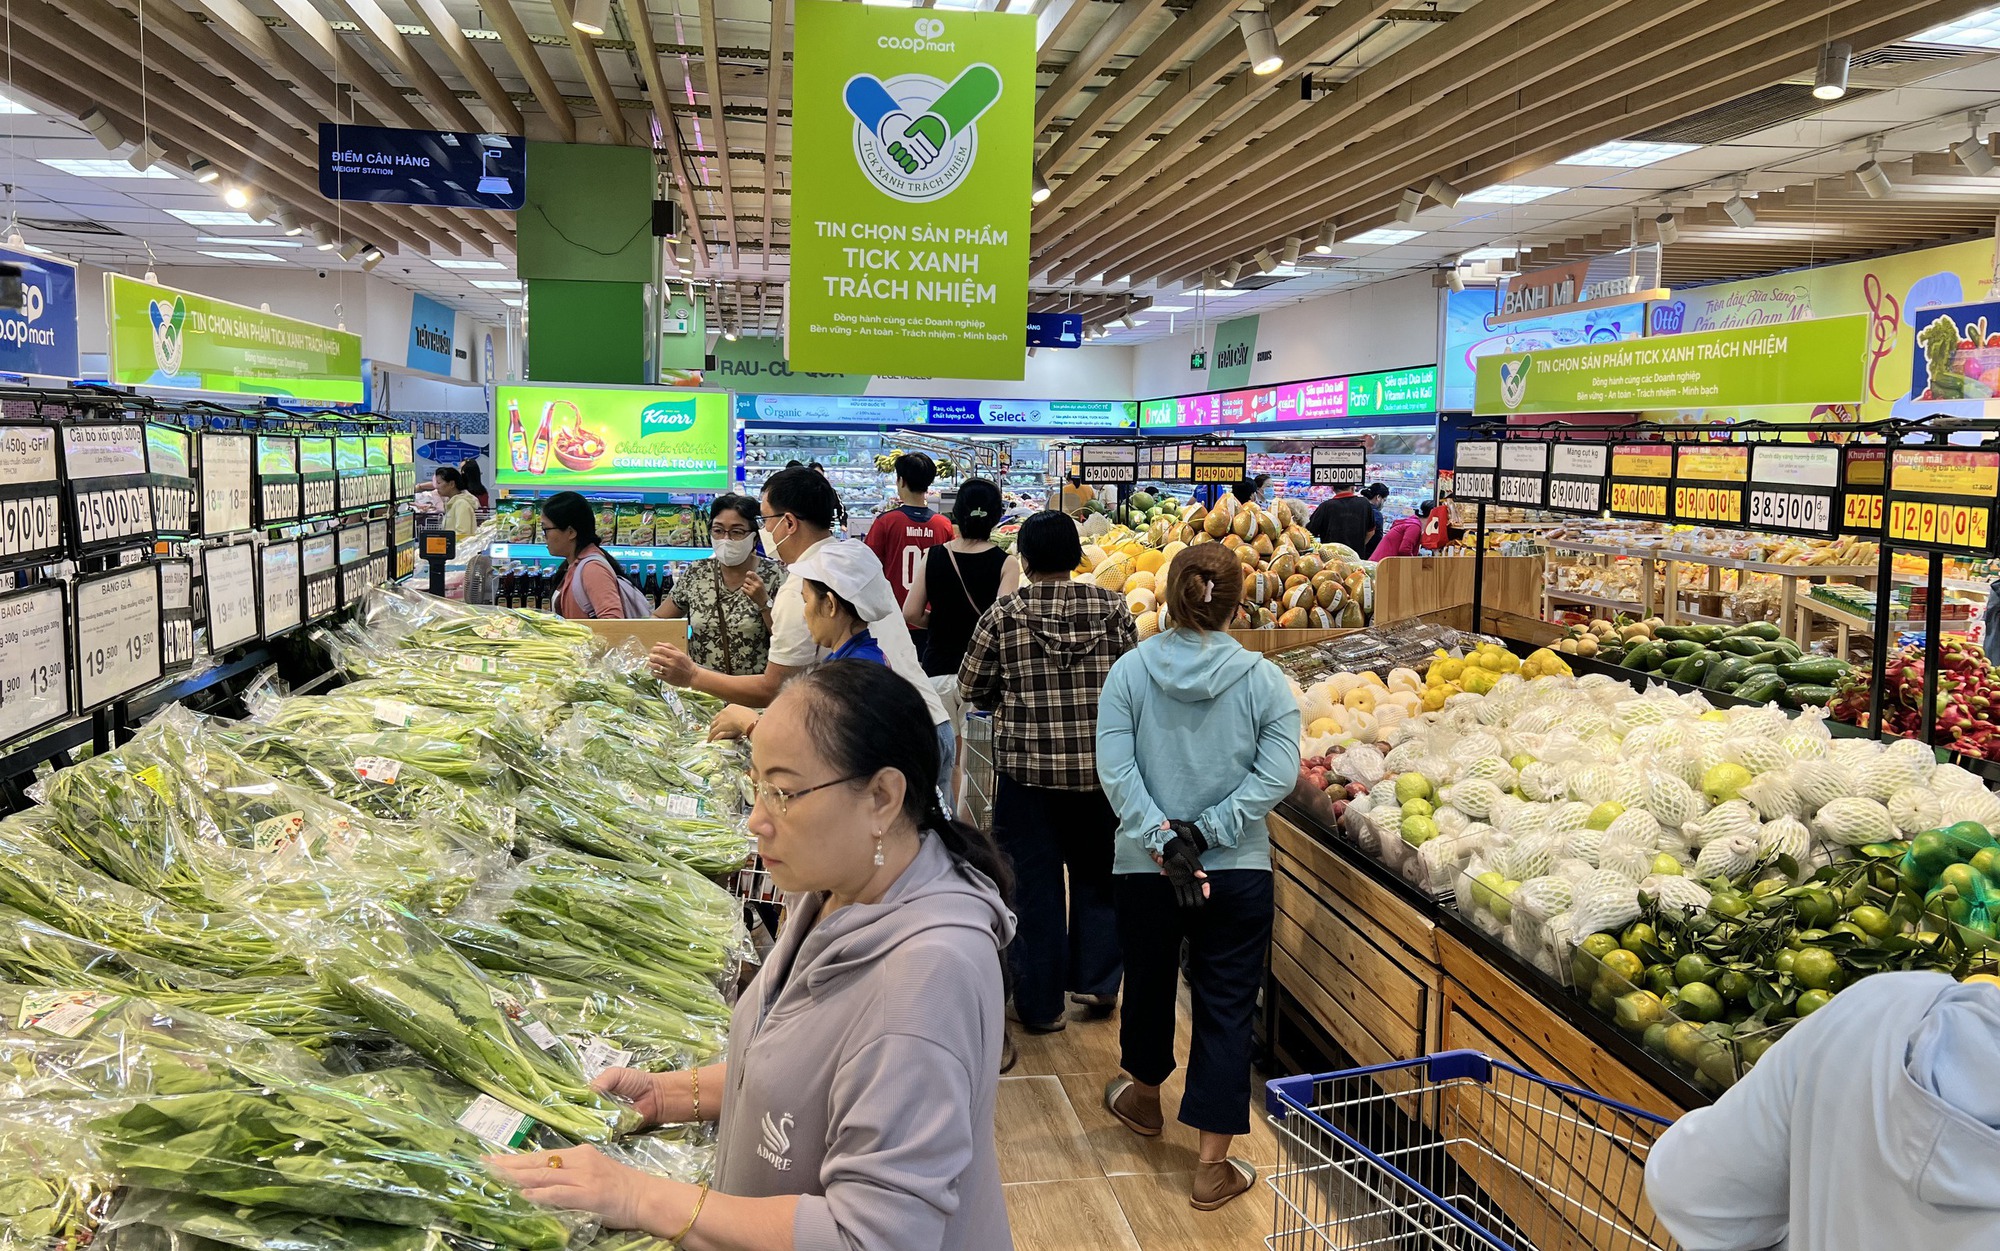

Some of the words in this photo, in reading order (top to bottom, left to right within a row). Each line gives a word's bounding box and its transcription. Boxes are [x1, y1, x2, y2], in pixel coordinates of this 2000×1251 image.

[332, 150, 363, 163] ĐIỂM
[366, 153, 392, 166] CÂN
[395, 154, 430, 170] HÀNG
[864, 140, 880, 167] TICK
[876, 166, 905, 190] XANH
[907, 177, 944, 191] TRÁCH
[944, 146, 968, 179] NHIỆM
[332, 165, 360, 174] WEIGHT
[362, 167, 394, 176] STATION
[815, 221, 846, 238] TIN
[851, 223, 906, 244] CHỌN
[911, 222, 949, 243] SẢN
[954, 224, 1008, 246] PHẨM
[842, 247, 900, 270] TICK
[908, 251, 978, 274] XANH
[823, 273, 908, 300] TRÁCH
[916, 277, 996, 308] NHIỆM
[1504, 284, 1549, 315] BÁNH
[1552, 275, 1576, 307] MÌ
[1586, 276, 1640, 301] BAKERY
[1770, 287, 1796, 308] Sáng
[191, 311, 207, 332] TIN
[208, 315, 233, 339] CHỌN
[234, 316, 250, 339] SẢN
[250, 320, 270, 344] PHẨM
[270, 329, 287, 347] TICK
[287, 333, 304, 350] XANH
[833, 313, 857, 325] Đồng
[859, 314, 881, 324] hành
[883, 315, 907, 327] cùng
[909, 316, 923, 325] các
[925, 317, 953, 327] Doanh
[955, 318, 985, 330] nghiệp
[810, 324, 828, 334] Bền
[830, 325, 852, 337] vững
[860, 326, 872, 335] An
[873, 327, 893, 337] toàn
[901, 328, 927, 338] Trách
[928, 329, 955, 341] nhiệm
[963, 331, 984, 341] Minh
[986, 332, 1008, 343] bạch
[1537, 360, 1551, 374] TIN
[1552, 358, 1579, 375] CHỌN
[1581, 353, 1601, 370] SẢN
[1603, 348, 1632, 368] PHẨM
[1635, 349, 1659, 365] TICK
[1661, 346, 1695, 363] XANH
[1697, 339, 1740, 360] TRÁCH
[1742, 334, 1788, 358] NHIỆM
[1592, 378, 1608, 388] Đồng
[1609, 376, 1624, 386] hành
[1625, 375, 1640, 386] cùng
[1641, 374, 1653, 383] các
[1654, 373, 1675, 383] Doanh
[1676, 371, 1701, 384] nghiệp
[1384, 388, 1405, 401] Vitamin
[1406, 388, 1412, 400] A
[1577, 391, 1588, 401] Bền
[1589, 391, 1604, 403] vững
[1608, 390, 1617, 400] An
[1618, 389, 1631, 399] toàn
[1637, 387, 1655, 398] Trách
[1656, 387, 1676, 400] nhiệm
[1682, 385, 1700, 396] Minh
[1700, 384, 1719, 398] bạch
[643, 409, 692, 425] Knorr
[764, 405, 802, 421] Organic
[989, 411, 1027, 422] Select
[125, 428, 141, 446] 300g
[6, 440, 26, 455] 450g
[1591, 449, 1599, 459] kg
[1848, 449, 1875, 461] Khuyến
[644, 456, 669, 469] NHÀ
[671, 456, 703, 469] TRÒN
[706, 459, 717, 472] VỊ
[1816, 454, 1828, 463] 500g
[1892, 453, 1923, 465] Khuyến
[1926, 453, 1943, 464] mãi
[1086, 468, 1124, 480] 69.000
[1196, 469, 1233, 479] 34.900
[1316, 470, 1353, 480] 25.000
[1968, 465, 1976, 474] kg
[1457, 476, 1485, 493] 51.500
[1501, 480, 1533, 499] 23.500
[1551, 484, 1590, 504] 89.000
[1613, 488, 1655, 508] 39.000
[1677, 490, 1727, 514] 39.000
[80, 495, 140, 531] 25.000
[1752, 497, 1813, 522] 38.500
[1847, 498, 1882, 520] 42.5
[906, 526, 923, 538] Minh
[923, 527, 934, 539] An
[1894, 506, 1967, 536] 12.900
[1972, 511, 1986, 540] đ/kg
[5, 574, 15, 592] kg
[1, 604, 21, 620] BẢNG
[22, 601, 35, 615] GIÁ
[5, 631, 19, 646] 300g
[86, 645, 118, 680] 19.500
[126, 632, 154, 665] 19.500
[30, 662, 62, 696] 13.900
[757, 1143, 793, 1171] ADORE
